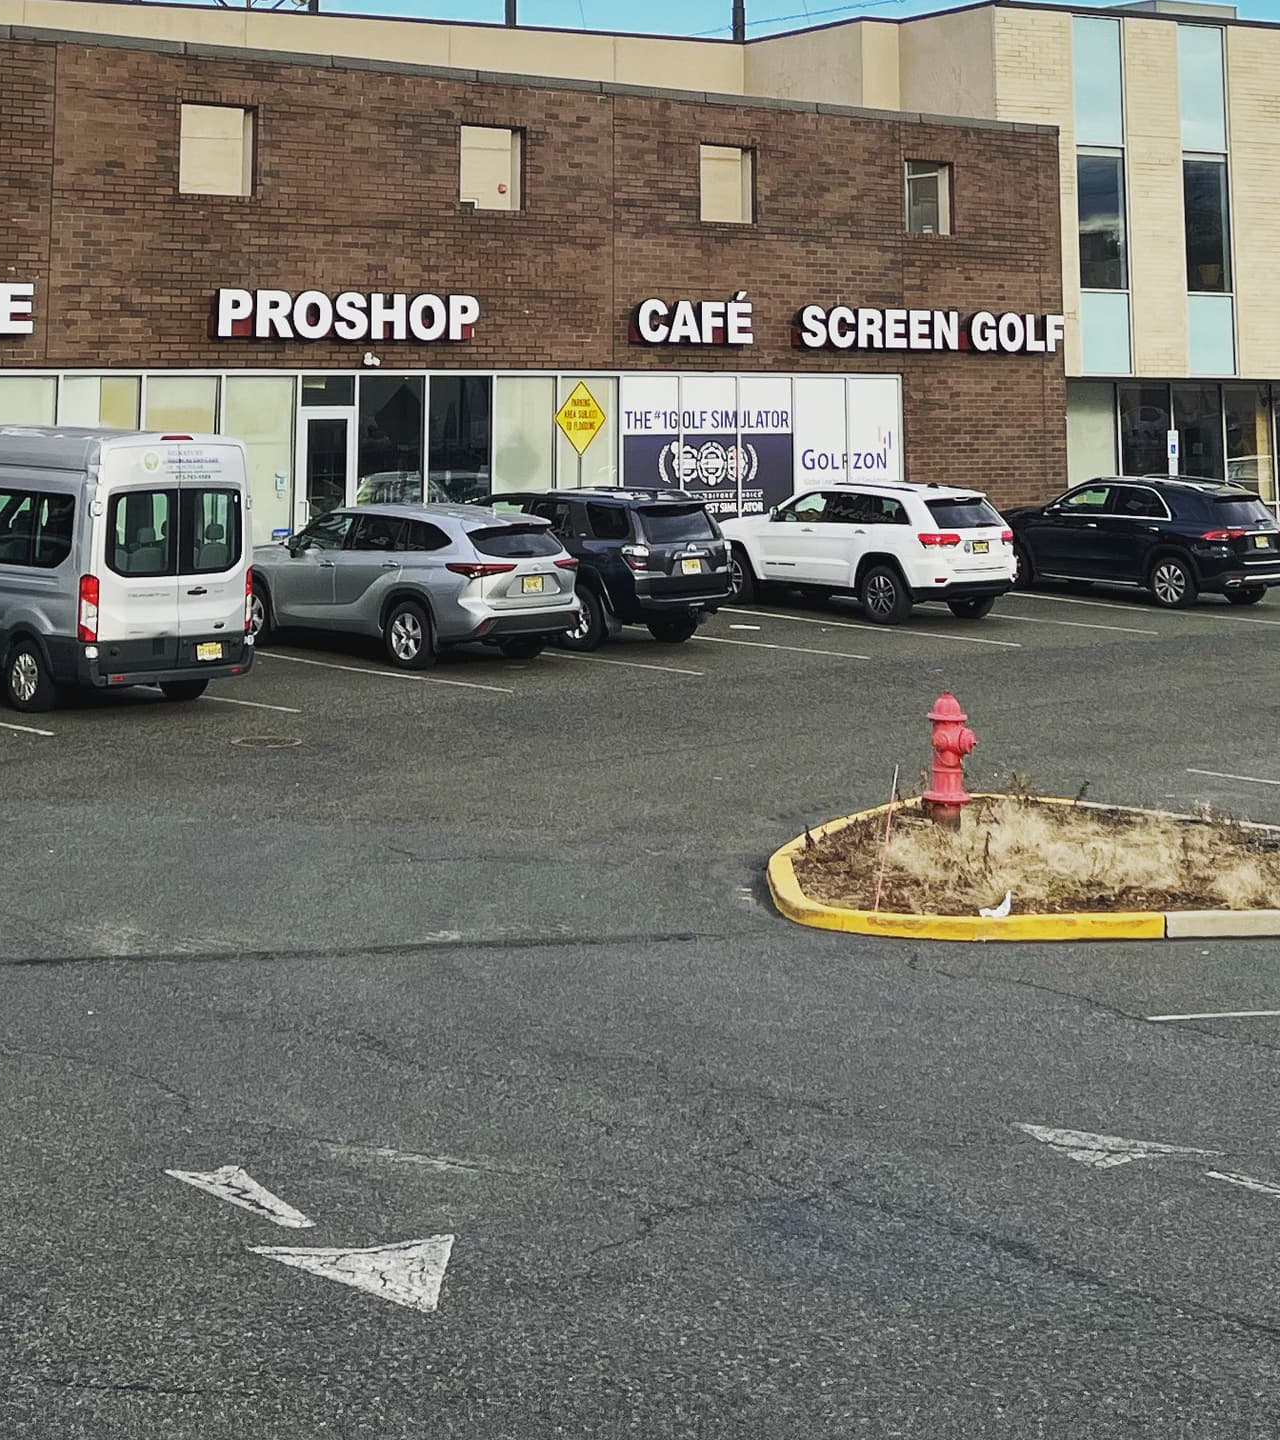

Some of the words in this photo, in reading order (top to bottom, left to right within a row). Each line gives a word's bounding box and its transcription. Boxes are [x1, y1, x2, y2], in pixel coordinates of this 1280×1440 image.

[217, 288, 480, 341] PROSHOP
[637, 291, 754, 344] CAFÉ
[800, 305, 960, 350] SCREEN
[970, 311, 1066, 353] GOLF
[624, 410, 652, 429] THE
